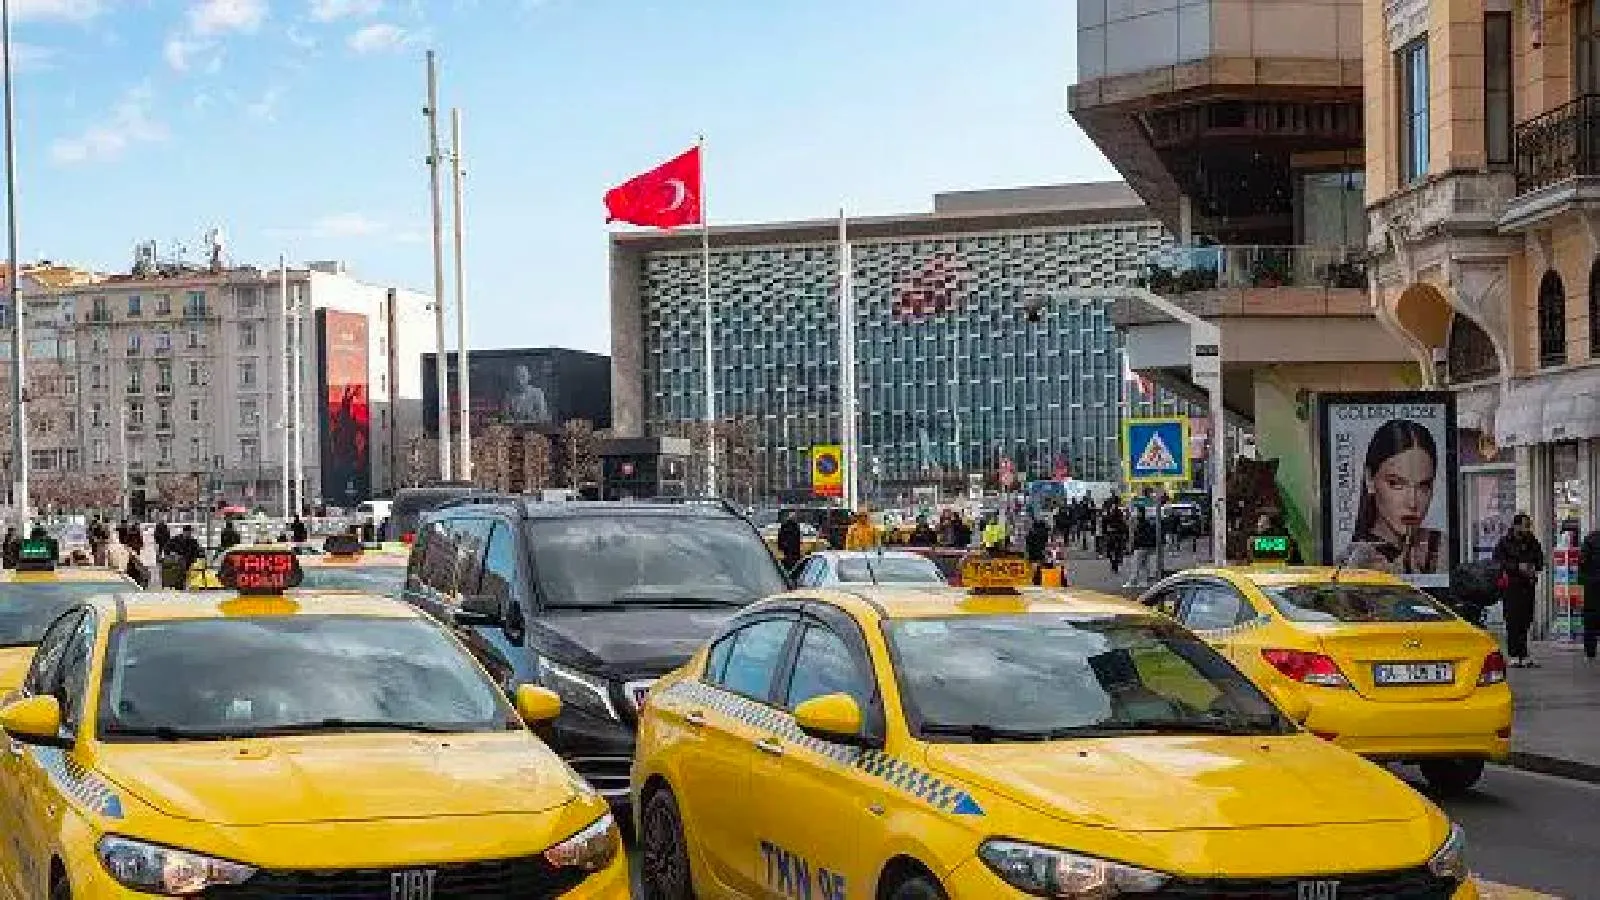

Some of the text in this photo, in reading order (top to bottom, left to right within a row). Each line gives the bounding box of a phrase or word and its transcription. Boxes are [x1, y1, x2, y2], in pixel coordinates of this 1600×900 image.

[1336, 406, 1437, 419] GOLDEN ROSE
[1336, 433, 1349, 488] MATTE
[227, 554, 292, 571] TAKSI
[969, 562, 1025, 575] TAKSI
[391, 869, 437, 900] FIAT
